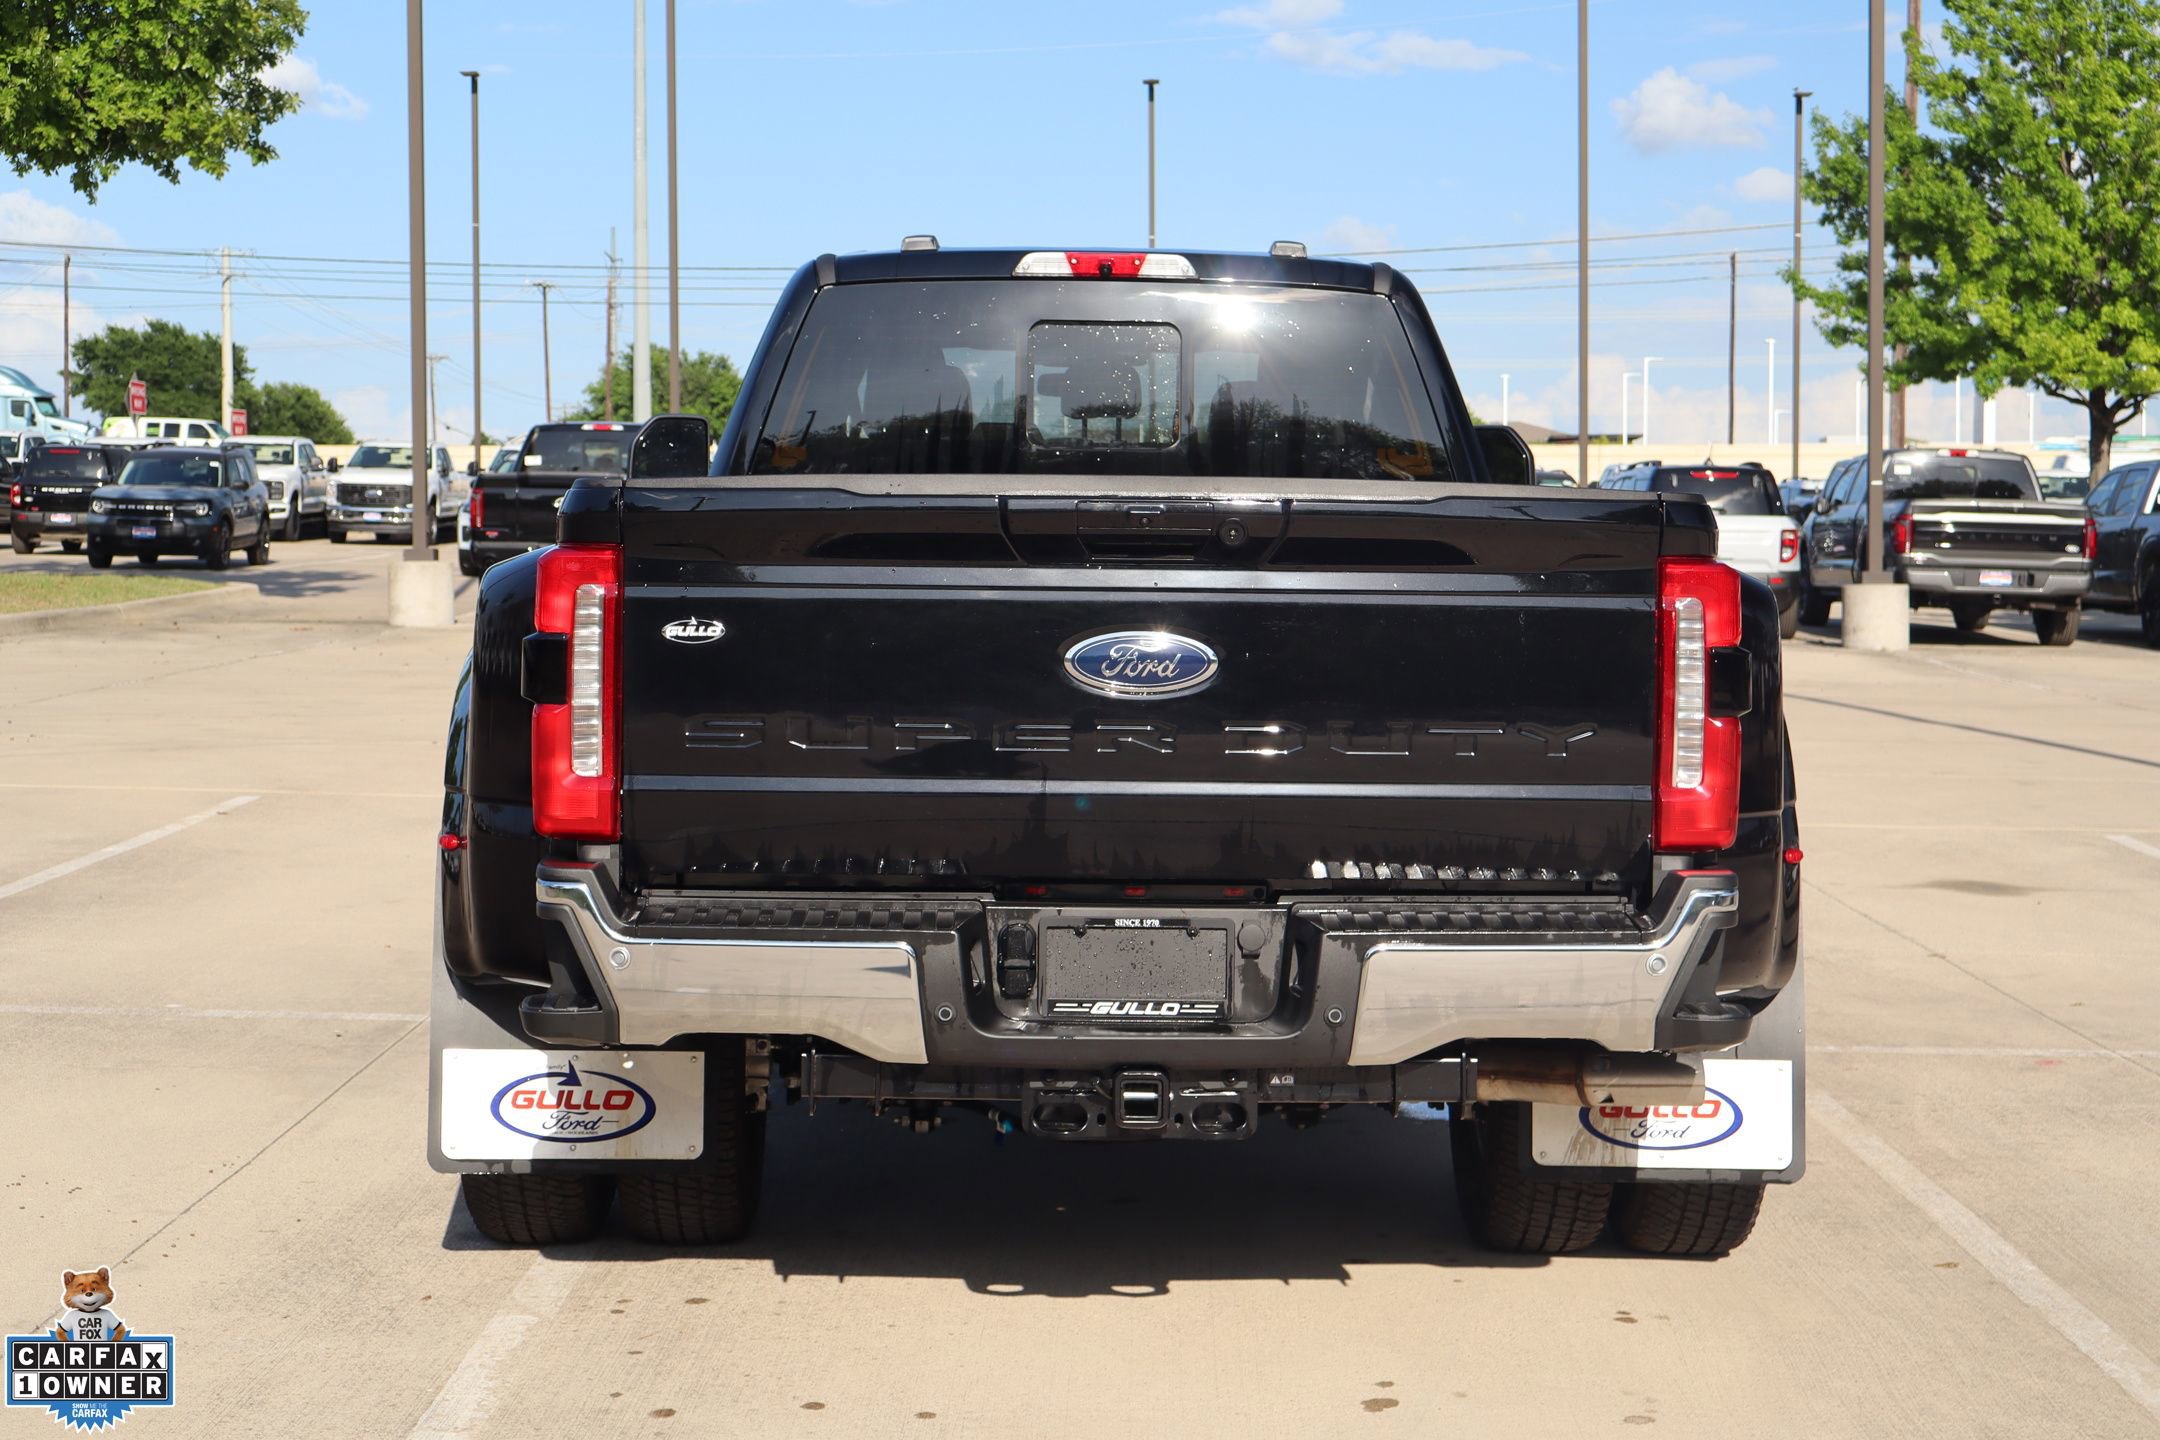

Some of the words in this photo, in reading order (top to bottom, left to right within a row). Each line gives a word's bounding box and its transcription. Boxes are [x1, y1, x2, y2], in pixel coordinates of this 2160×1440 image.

[666, 626, 721, 636] GULLO
[1101, 644, 1181, 677] Ford
[683, 713, 1177, 753] SUPER
[1222, 720, 1598, 757] DUTY
[1114, 918, 1140, 927] SINCE
[1143, 919, 1160, 927] 1970
[1089, 1002, 1180, 1015] GULLO
[511, 1090, 635, 1110] GULLO
[542, 1110, 604, 1131] Ford
[1630, 1119, 1691, 1139] Ford
